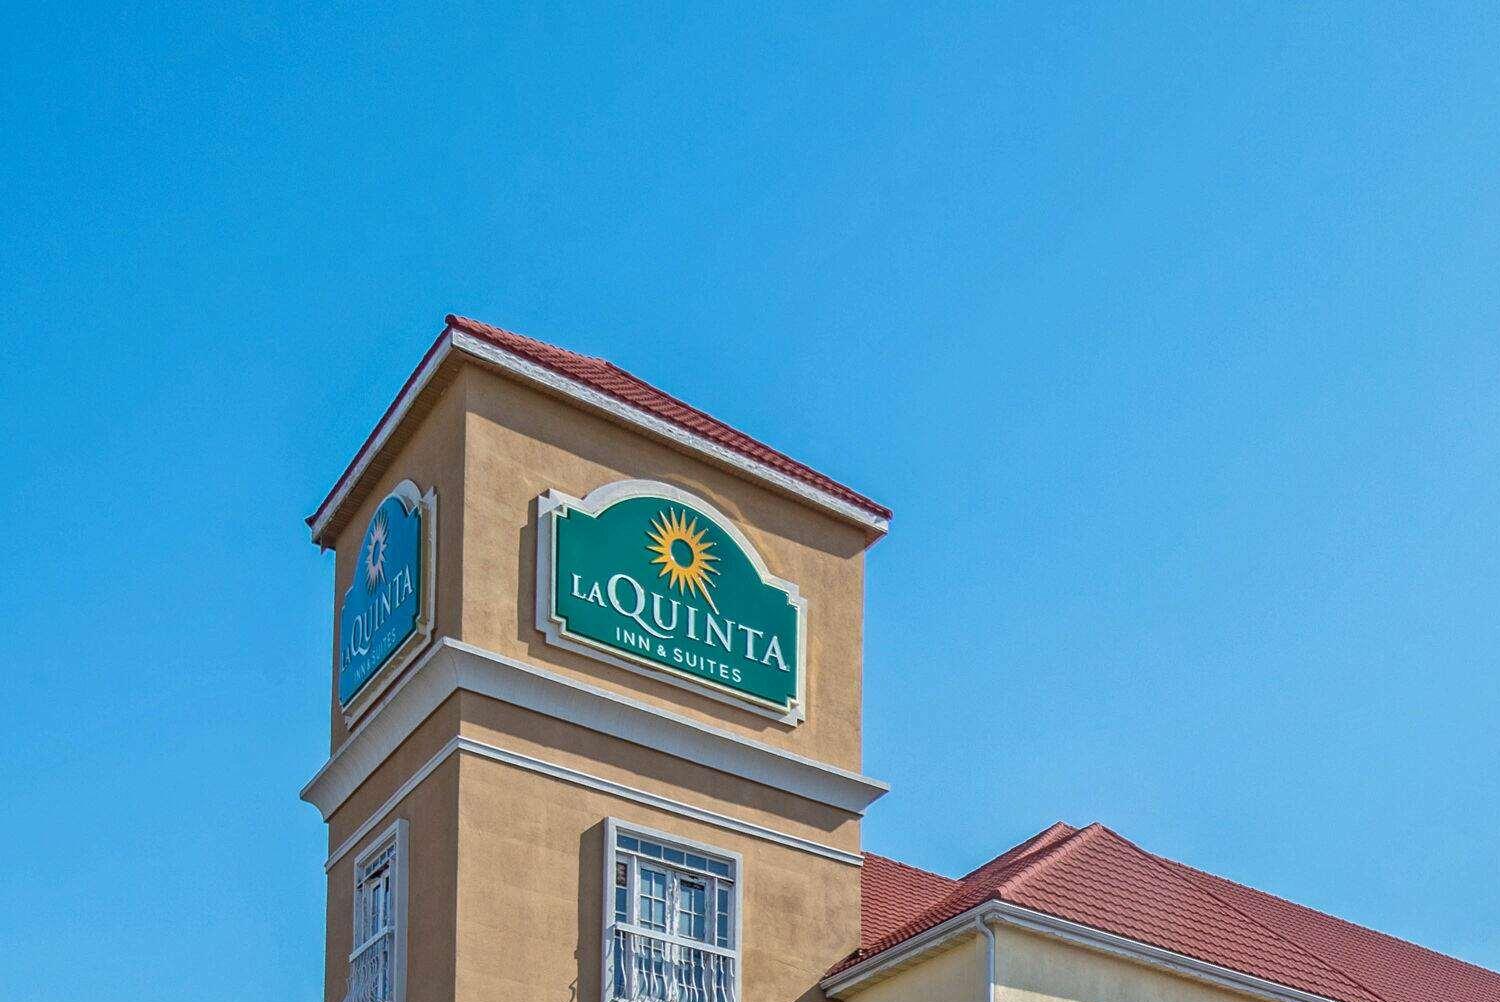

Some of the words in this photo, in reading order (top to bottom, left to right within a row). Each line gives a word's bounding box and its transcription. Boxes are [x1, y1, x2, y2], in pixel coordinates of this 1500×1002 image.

[352, 565, 413, 656] QUINTA
[607, 573, 790, 672] QUINTA
[616, 627, 650, 651] INN
[657, 645, 667, 657] &
[673, 648, 742, 683] SUITES
